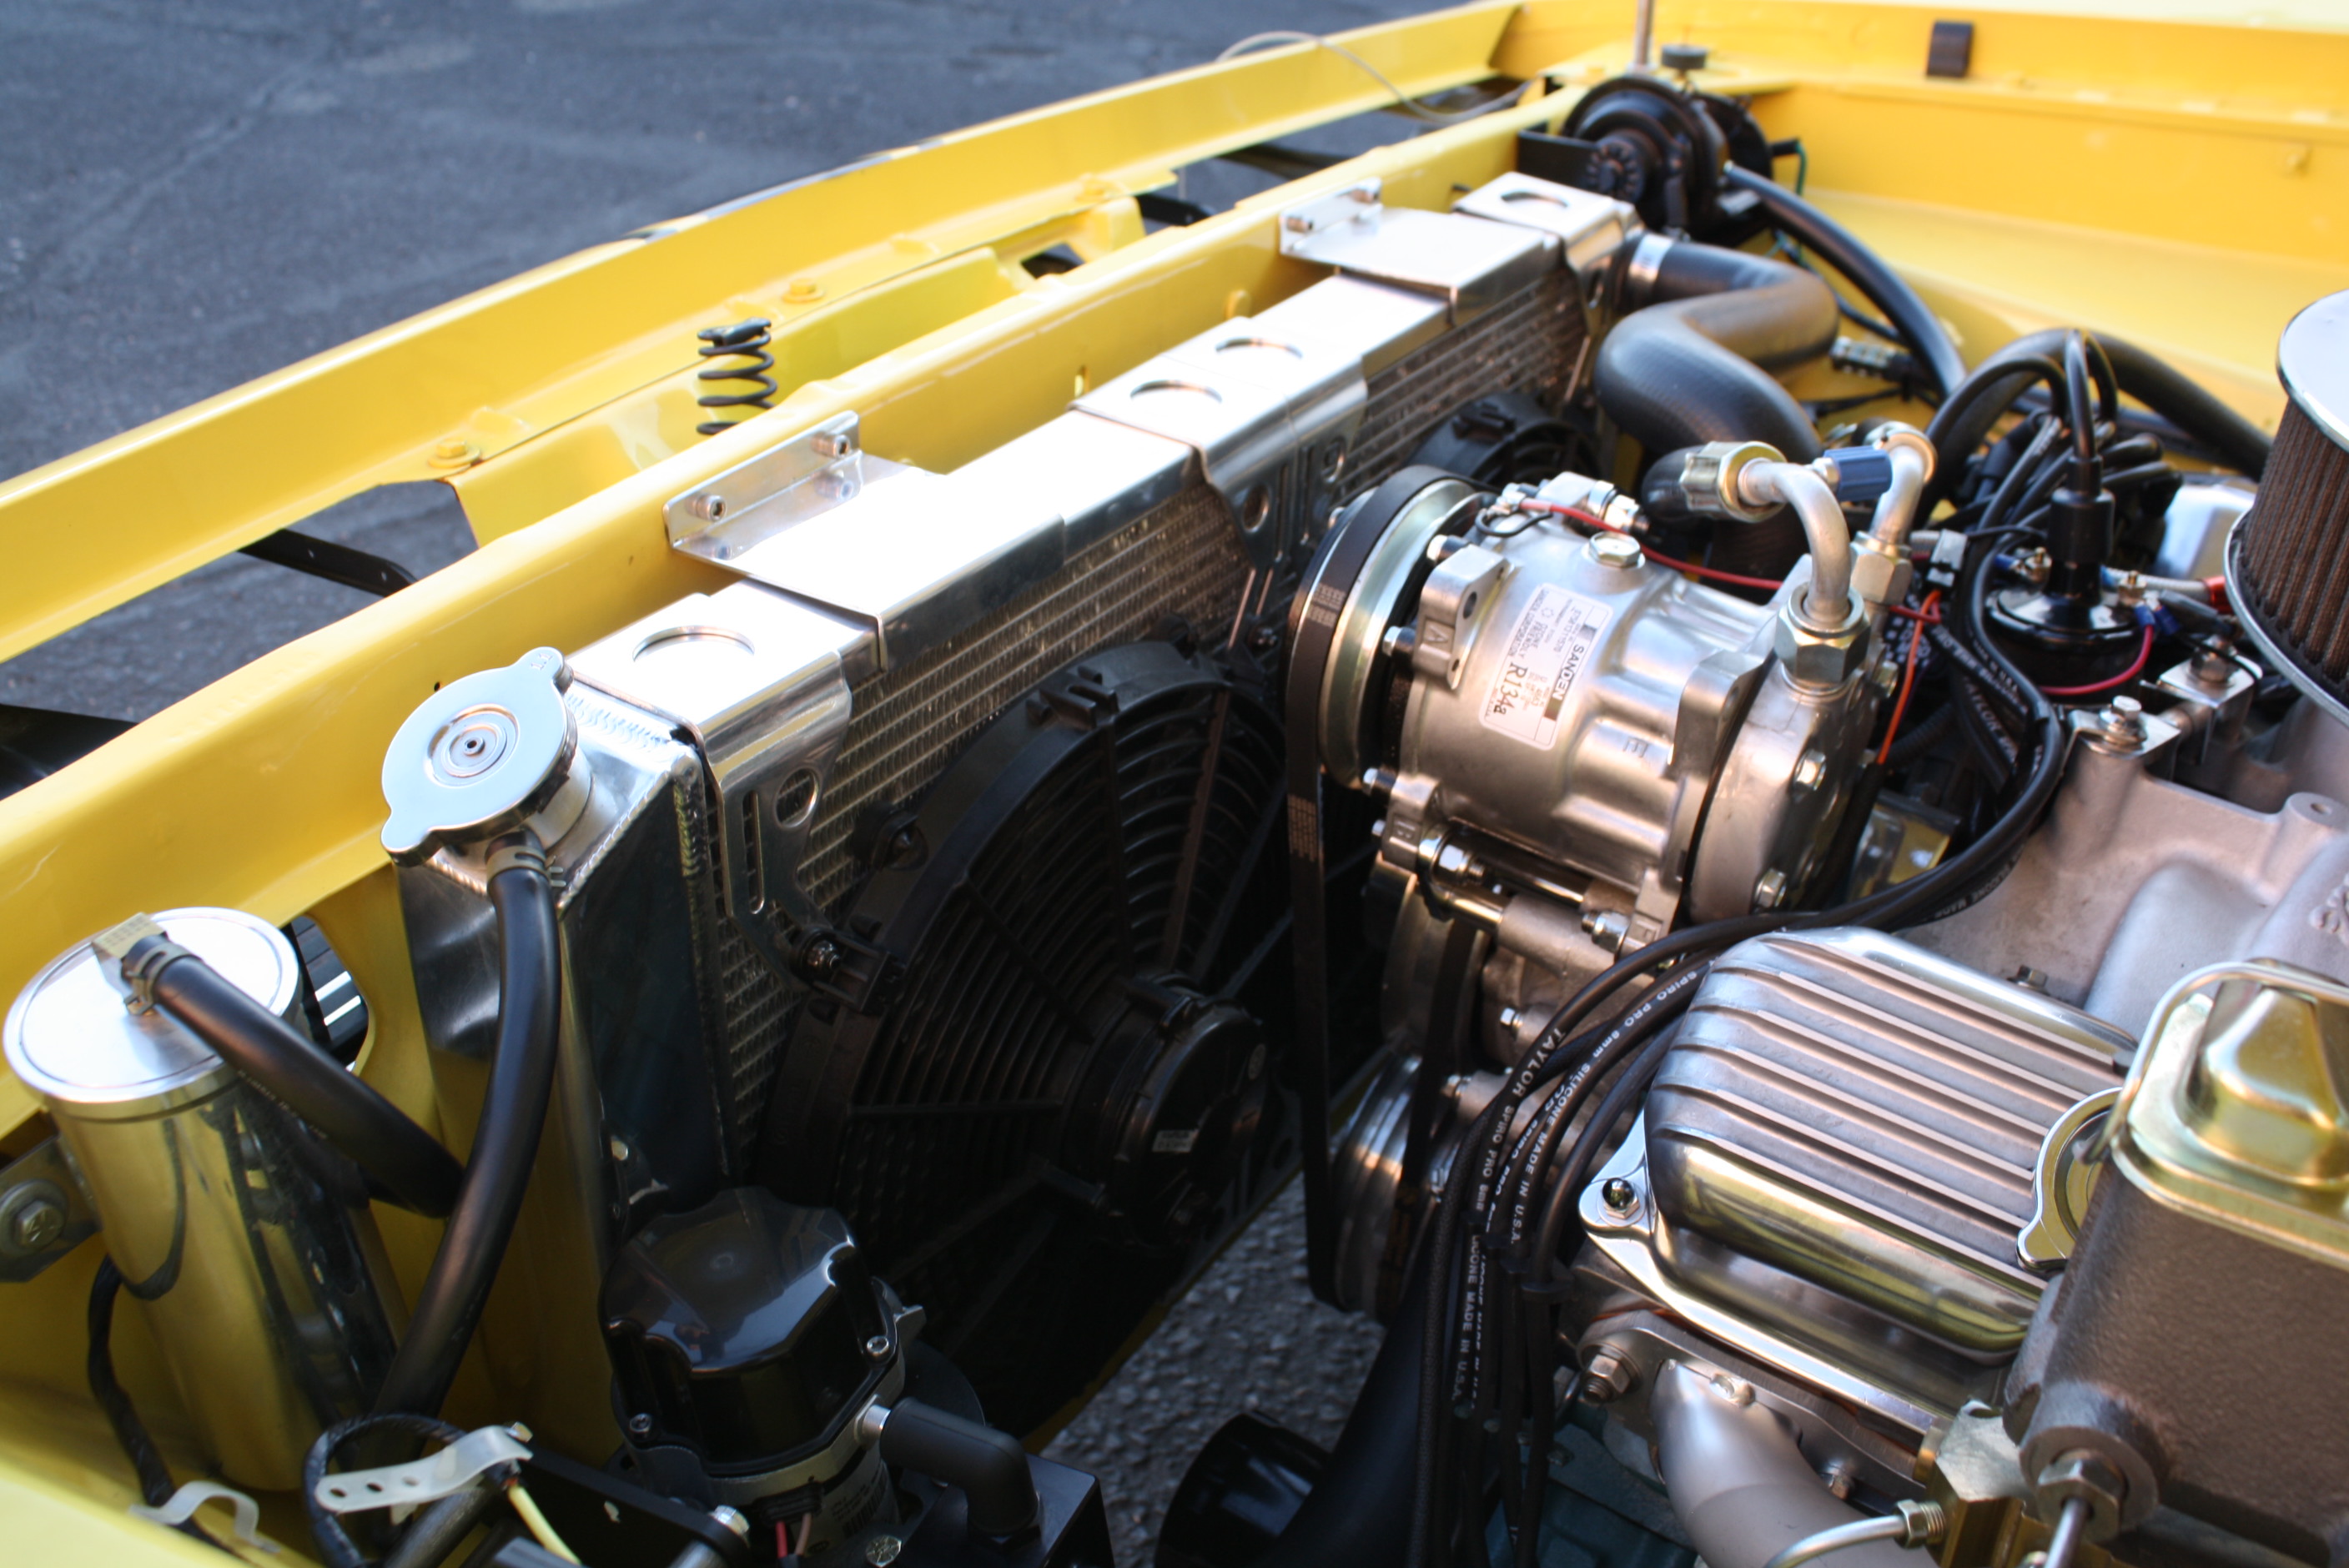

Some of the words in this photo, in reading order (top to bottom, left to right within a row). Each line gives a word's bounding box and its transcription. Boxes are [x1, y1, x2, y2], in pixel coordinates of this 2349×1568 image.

[1492, 661, 1527, 717] R134a
[1552, 643, 1585, 700] SANDEN
[1657, 970, 1698, 1002] SPIRO
[1624, 1003, 1652, 1027] PRO
[1512, 1027, 1567, 1098] TAYLOR
[1592, 1030, 1620, 1058] 8mm
[1546, 1063, 1591, 1127] SILICONE
[1492, 1105, 1515, 1143] SPIRO
[1482, 1149, 1498, 1178] PRO
[1525, 1131, 1547, 1174] MADE
[1518, 1180, 1531, 1197] IN
[1511, 1204, 1525, 1244] U.S.A.
[1462, 1291, 1476, 1332] MADE
[1460, 1339, 1471, 1354] IN
[1451, 1360, 1468, 1401] U.S.A.
